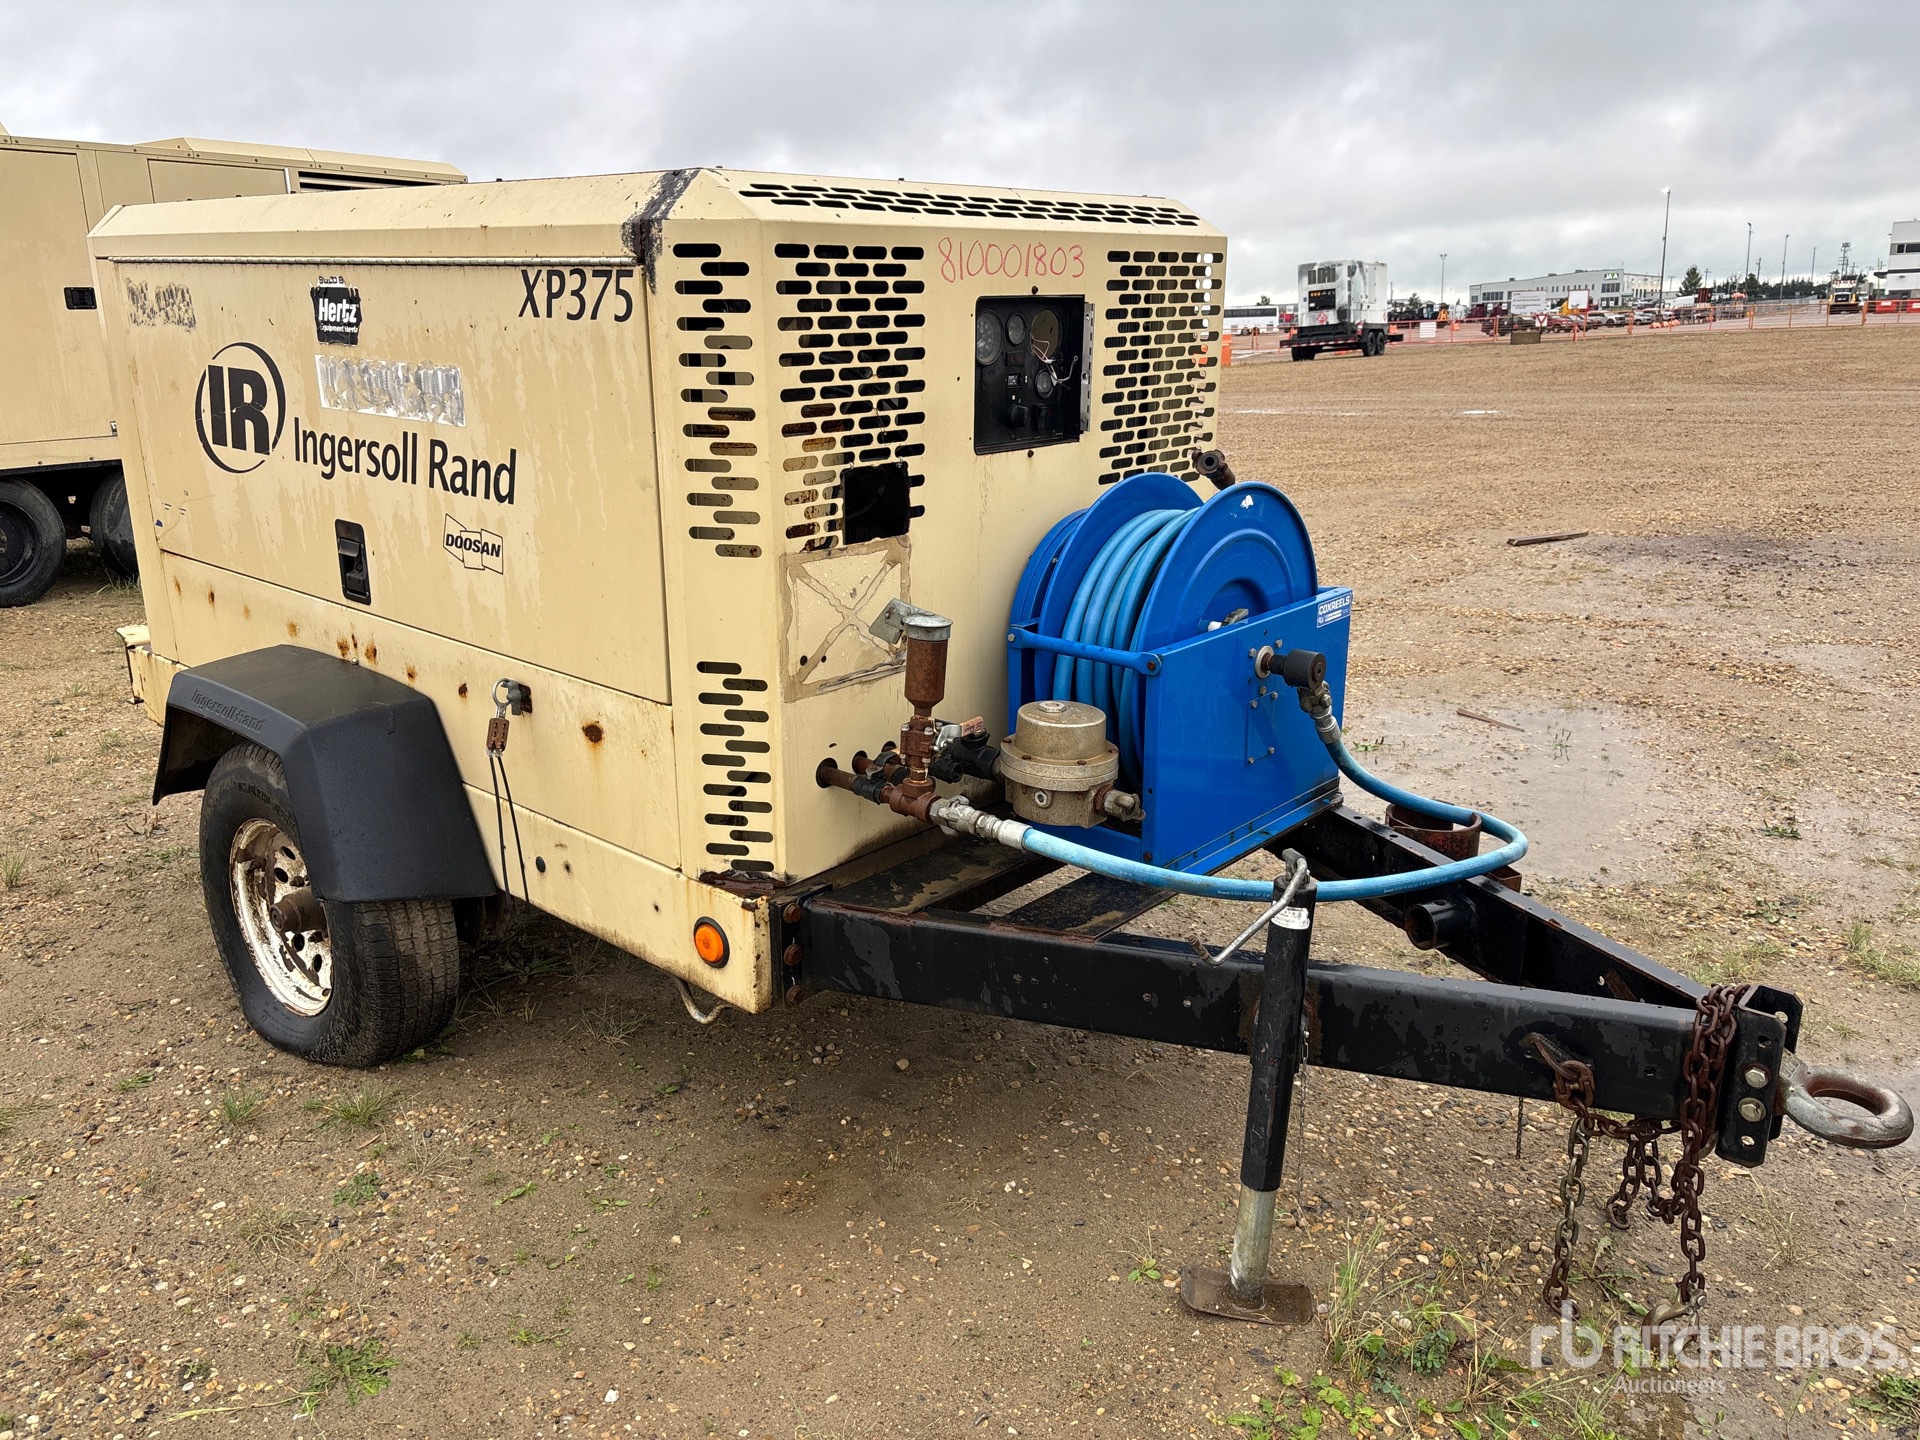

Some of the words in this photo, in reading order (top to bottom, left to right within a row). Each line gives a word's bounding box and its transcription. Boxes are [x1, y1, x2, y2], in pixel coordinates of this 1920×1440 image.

[938, 237, 1085, 283] 810001803
[318, 298, 357, 323] Hertz
[518, 268, 634, 323] XP375
[207, 364, 270, 456] IR
[293, 417, 418, 485] Ingersoll
[428, 438, 517, 505] Rand
[445, 533, 501, 558] DOOSAN
[1318, 595, 1350, 616] COXREELS
